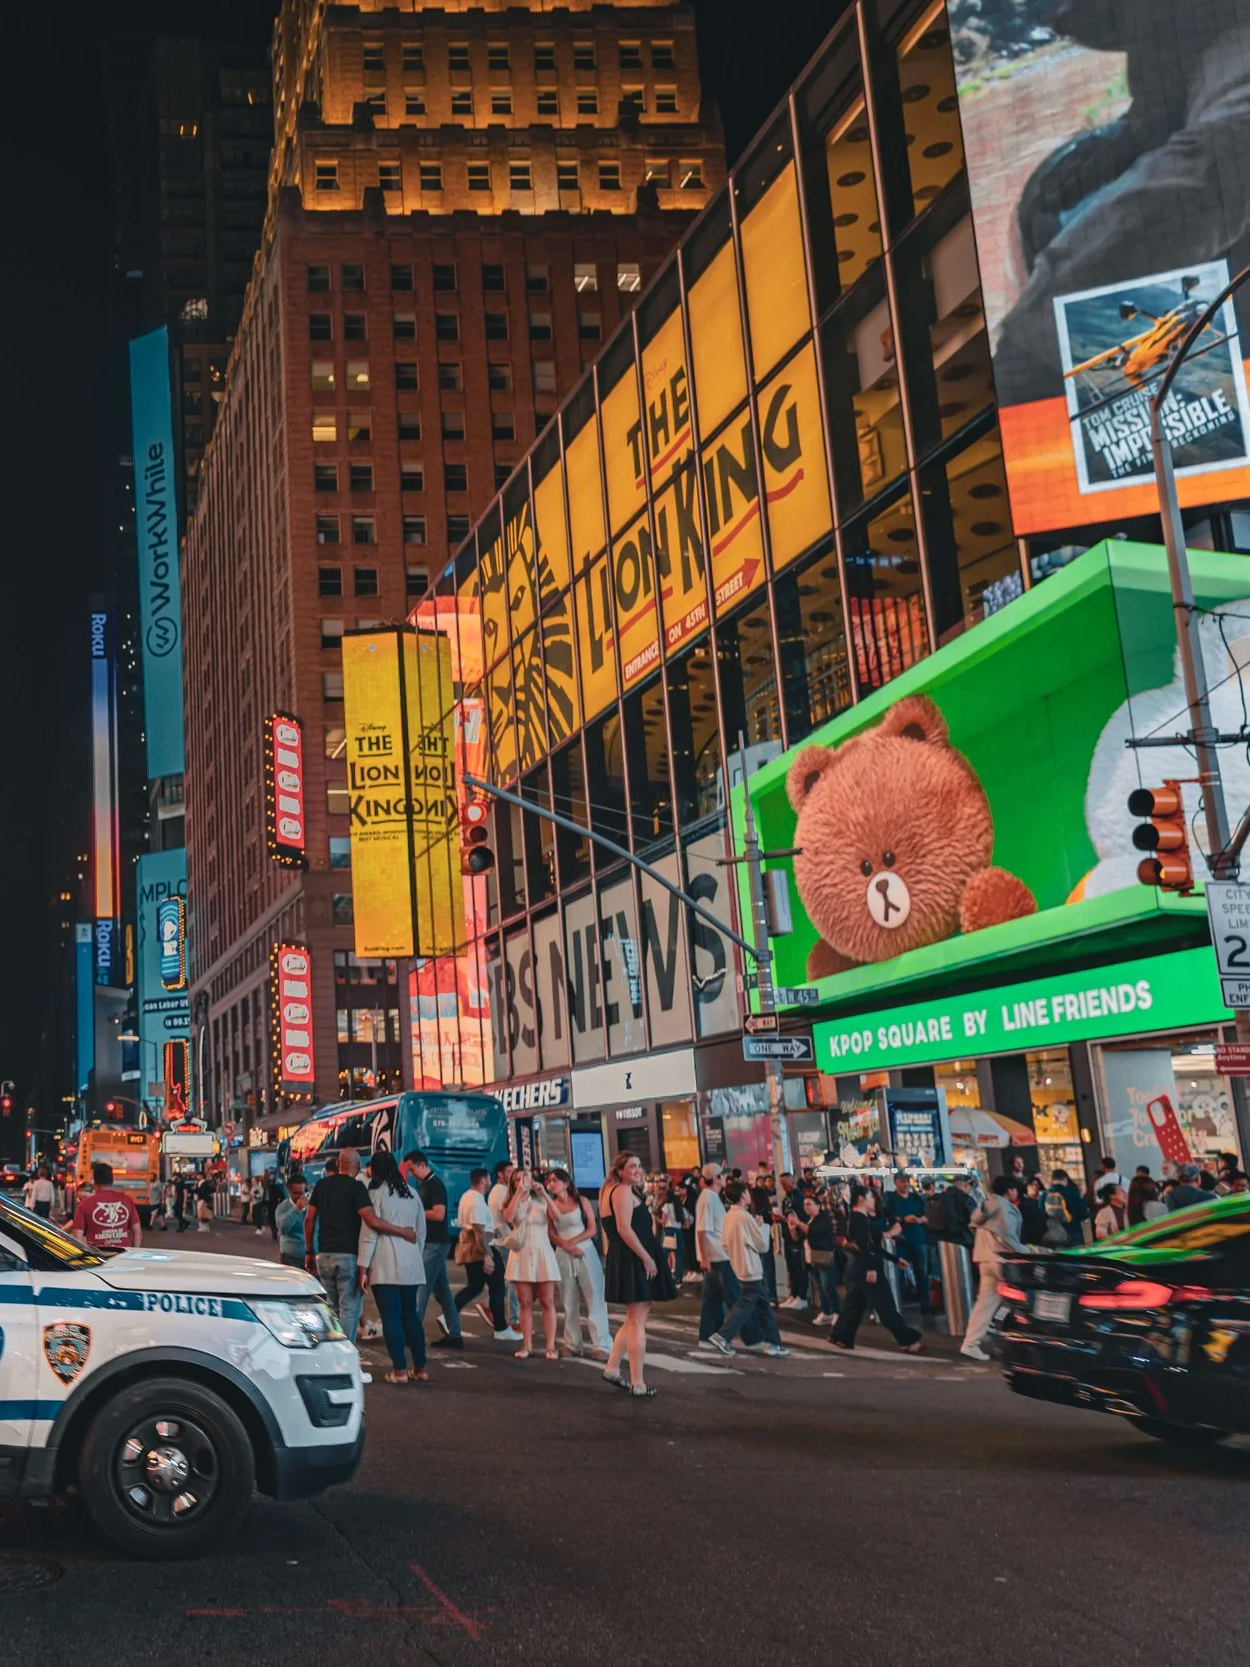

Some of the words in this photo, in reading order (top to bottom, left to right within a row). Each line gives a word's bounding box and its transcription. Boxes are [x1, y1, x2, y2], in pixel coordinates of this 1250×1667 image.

[1112, 382, 1159, 416] CRUISE
[627, 364, 691, 480] THE
[1081, 408, 1112, 430] TOM
[1088, 388, 1184, 453] MISSIN:
[1102, 388, 1232, 471] IMPOSIBLE
[144, 440, 169, 617] WorkWhile
[583, 504, 671, 675] LION
[672, 384, 803, 596] KING
[624, 634, 660, 681] ENTRANCE
[668, 620, 683, 643] ON
[715, 570, 745, 607] STREET
[354, 734, 393, 753] THE
[349, 761, 400, 790] LION
[489, 948, 544, 1056] BS
[548, 873, 728, 1042] NEWS
[787, 990, 795, 1003] W
[797, 990, 809, 1003] 45
[829, 1029, 874, 1058] KPOP
[878, 1013, 953, 1052] SQUARE
[963, 1009, 988, 1037] BY
[1001, 999, 1049, 1032] LINE
[1052, 978, 1154, 1023] FRIENDS
[754, 1042, 772, 1053] ONE
[781, 1042, 802, 1053] WAY
[1217, 1053, 1247, 1063] Anytime
[489, 1078, 562, 1113] KECHERS
[149, 1292, 219, 1317] POLICE
